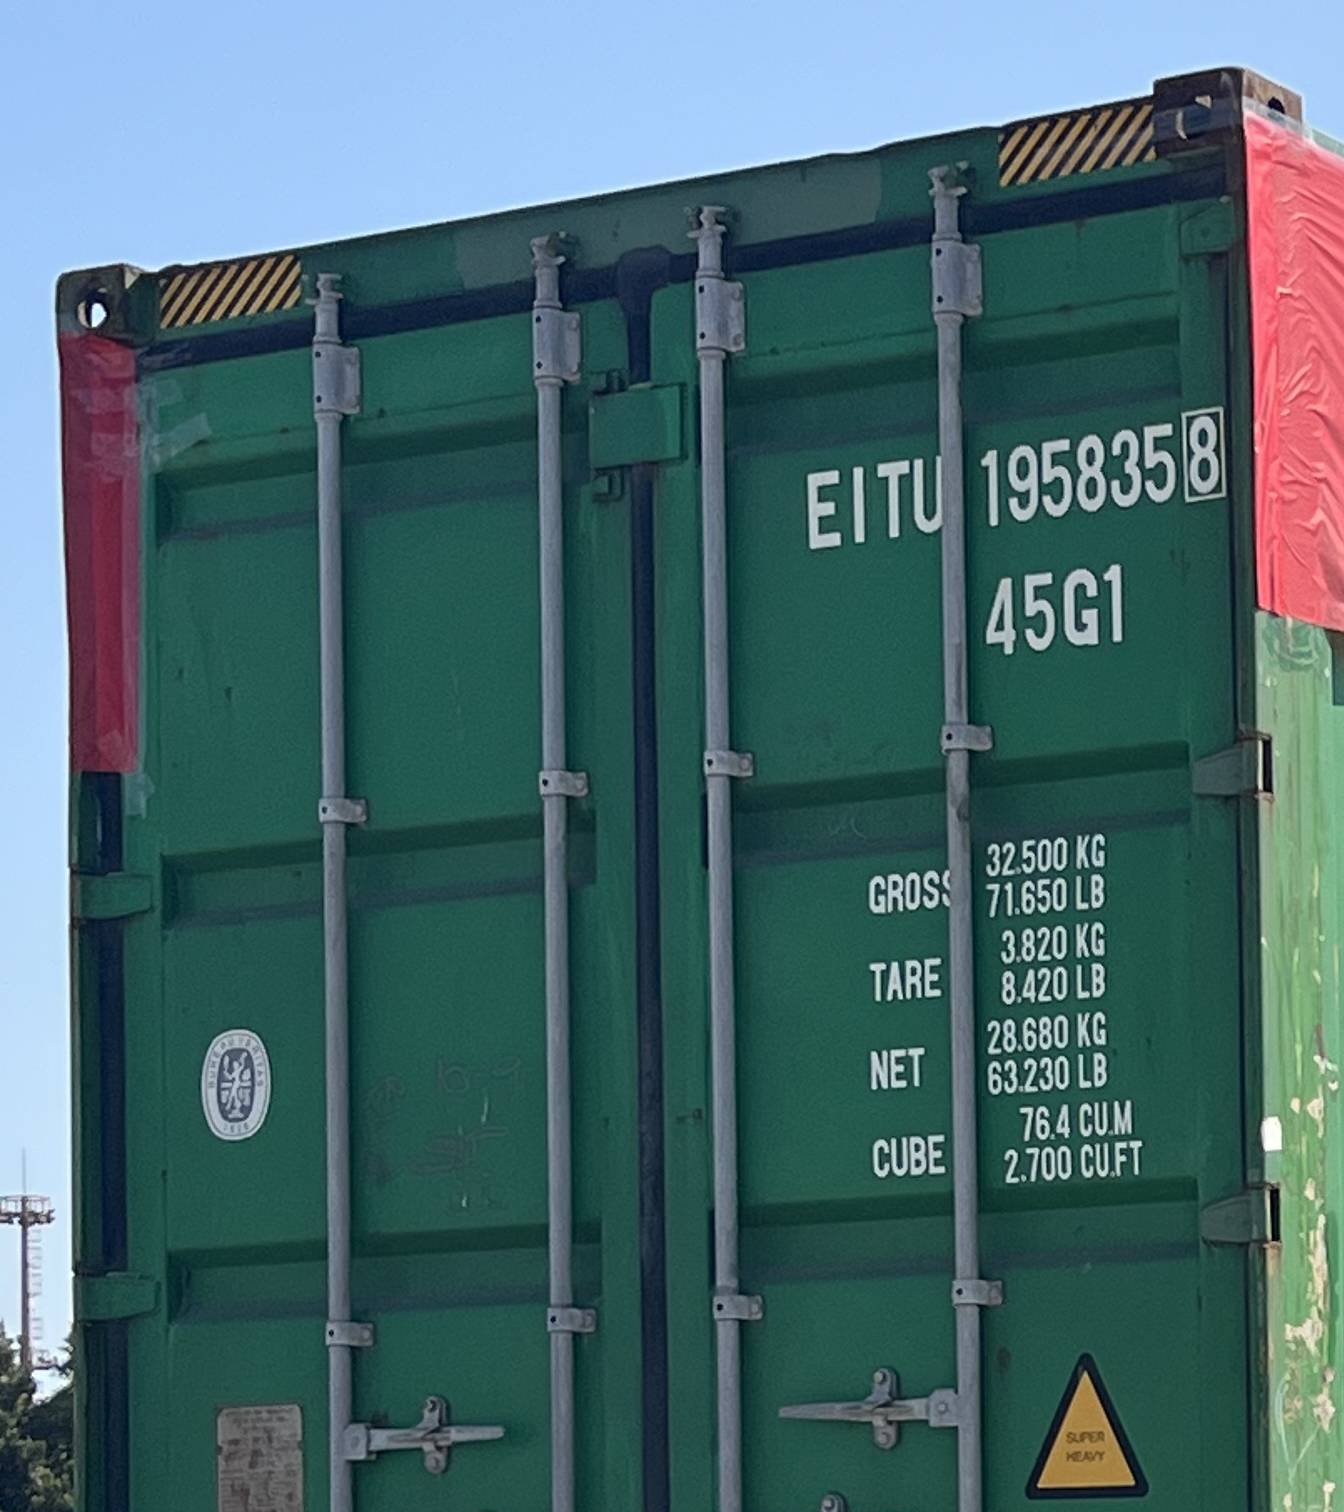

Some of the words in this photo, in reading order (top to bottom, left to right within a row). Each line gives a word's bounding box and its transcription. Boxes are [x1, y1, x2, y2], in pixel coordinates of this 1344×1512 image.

[807, 455, 943, 549] EITU
[986, 565, 1123, 655] 45G1
[986, 837, 1068, 877] 32.500
[1075, 834, 1106, 868] KG
[986, 876, 1067, 918] 71.650
[1075, 874, 1105, 910] LB
[1000, 925, 1067, 964] 3.820
[1075, 922, 1106, 957] KG
[869, 957, 942, 1002] TARE
[1001, 966, 1067, 1005] 8.420
[1076, 963, 1106, 999] LB
[987, 1015, 1069, 1054] 28.680
[1076, 1012, 1107, 1048] KG
[869, 1047, 925, 1091] NET
[987, 1056, 1070, 1095] 63.230
[1077, 1053, 1108, 1089] LB
[1019, 1104, 1071, 1143] 76.4
[872, 1134, 946, 1179] CUBE
[1004, 1145, 1072, 1184] 2.700
[1066, 1431, 1105, 1444] SUPER
[1066, 1451, 1105, 1463] HEAVY
